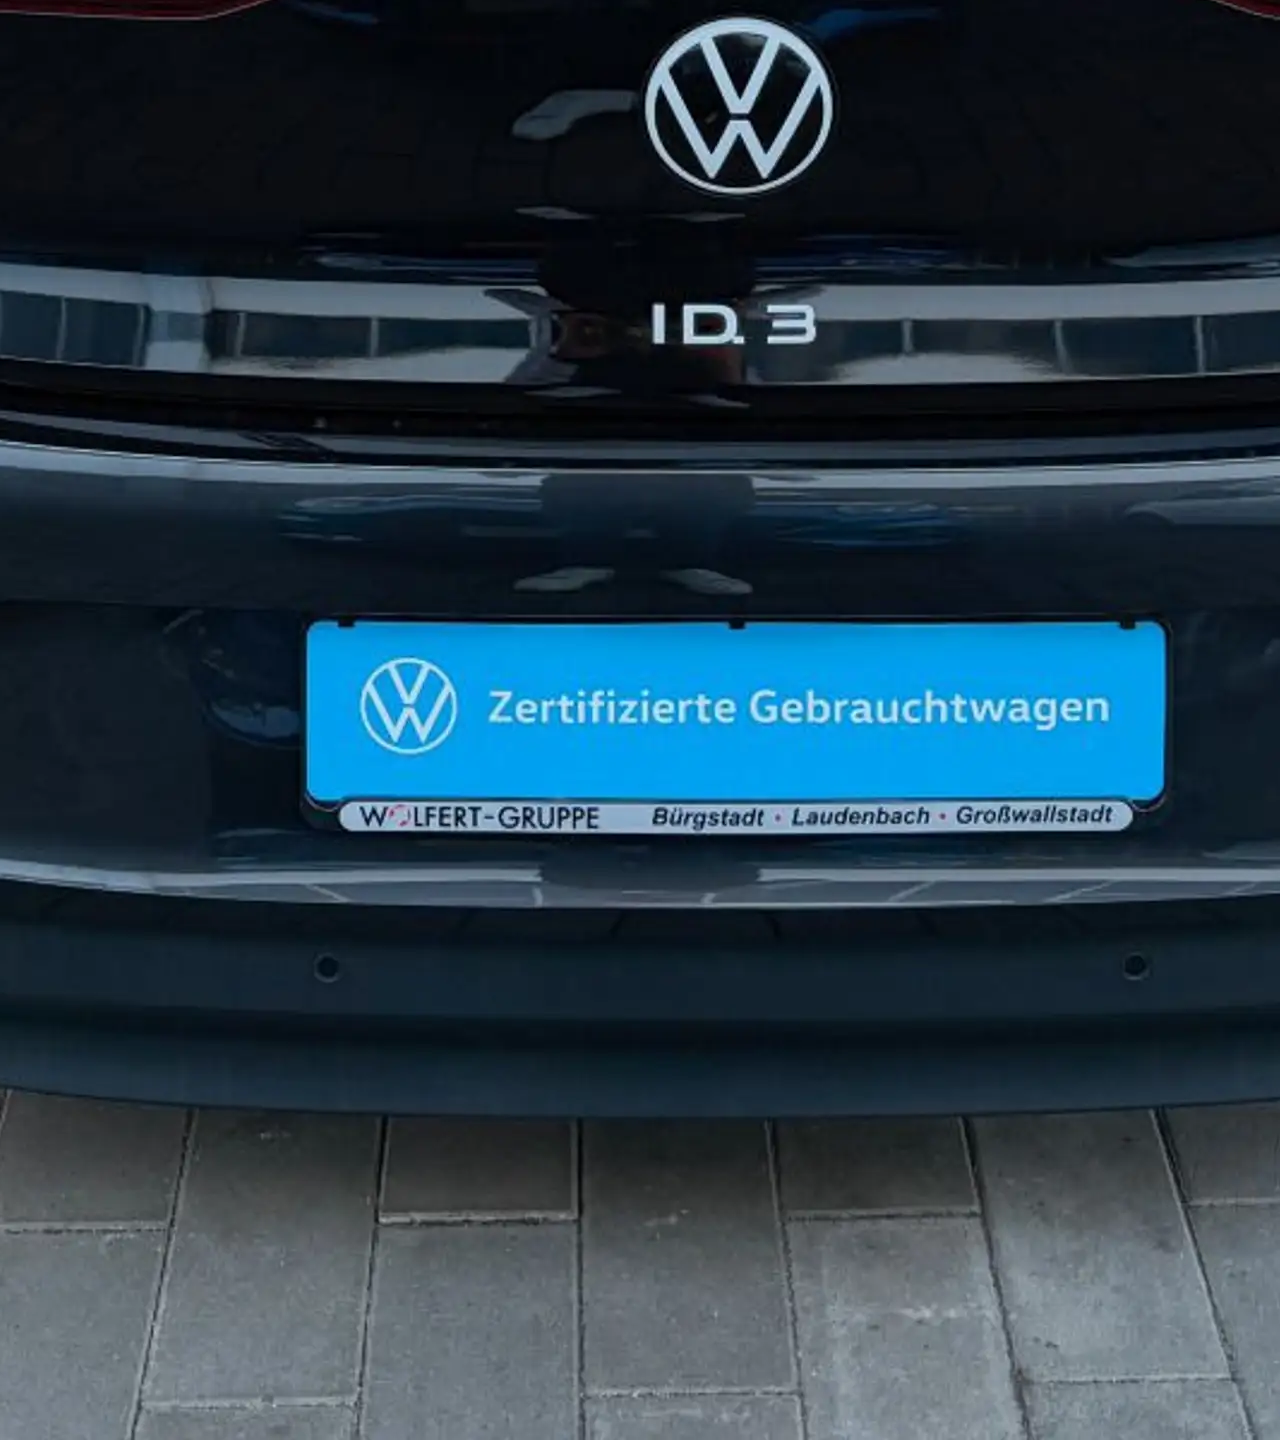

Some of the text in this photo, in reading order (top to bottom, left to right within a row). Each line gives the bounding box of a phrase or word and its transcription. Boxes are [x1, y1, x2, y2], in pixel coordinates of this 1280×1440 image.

[647, 19, 831, 193] VW
[361, 657, 458, 755] VW
[487, 689, 1111, 732] Zertifizierte Gebrauchtwagen
[359, 804, 600, 832] WOLFERT-GRUPPE
[651, 804, 1114, 832] Bürgstadt Laudenbach Großwallstadt
